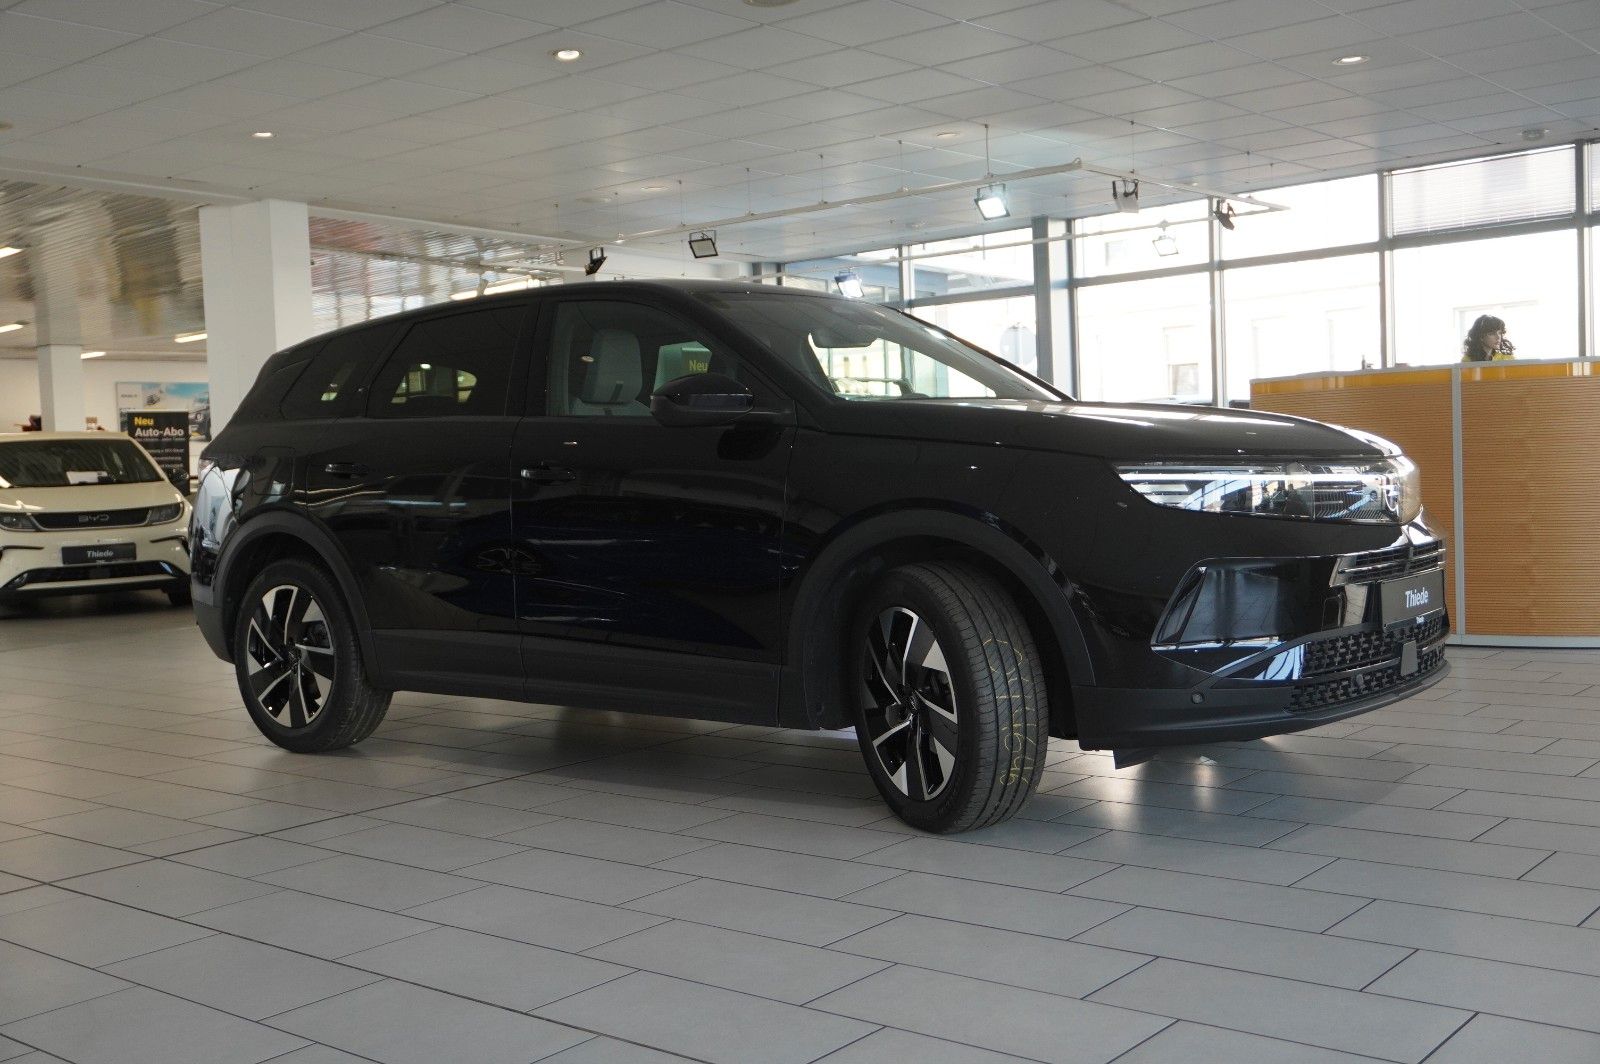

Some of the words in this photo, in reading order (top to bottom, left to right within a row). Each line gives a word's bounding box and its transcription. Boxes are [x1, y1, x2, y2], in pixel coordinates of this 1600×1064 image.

[689, 359, 708, 371] Neu
[134, 417, 154, 425] Neu
[135, 427, 184, 437] Auto-Abo
[79, 514, 109, 522] BYD
[87, 550, 113, 558] Thiede
[1405, 587, 1429, 608] Thiede
